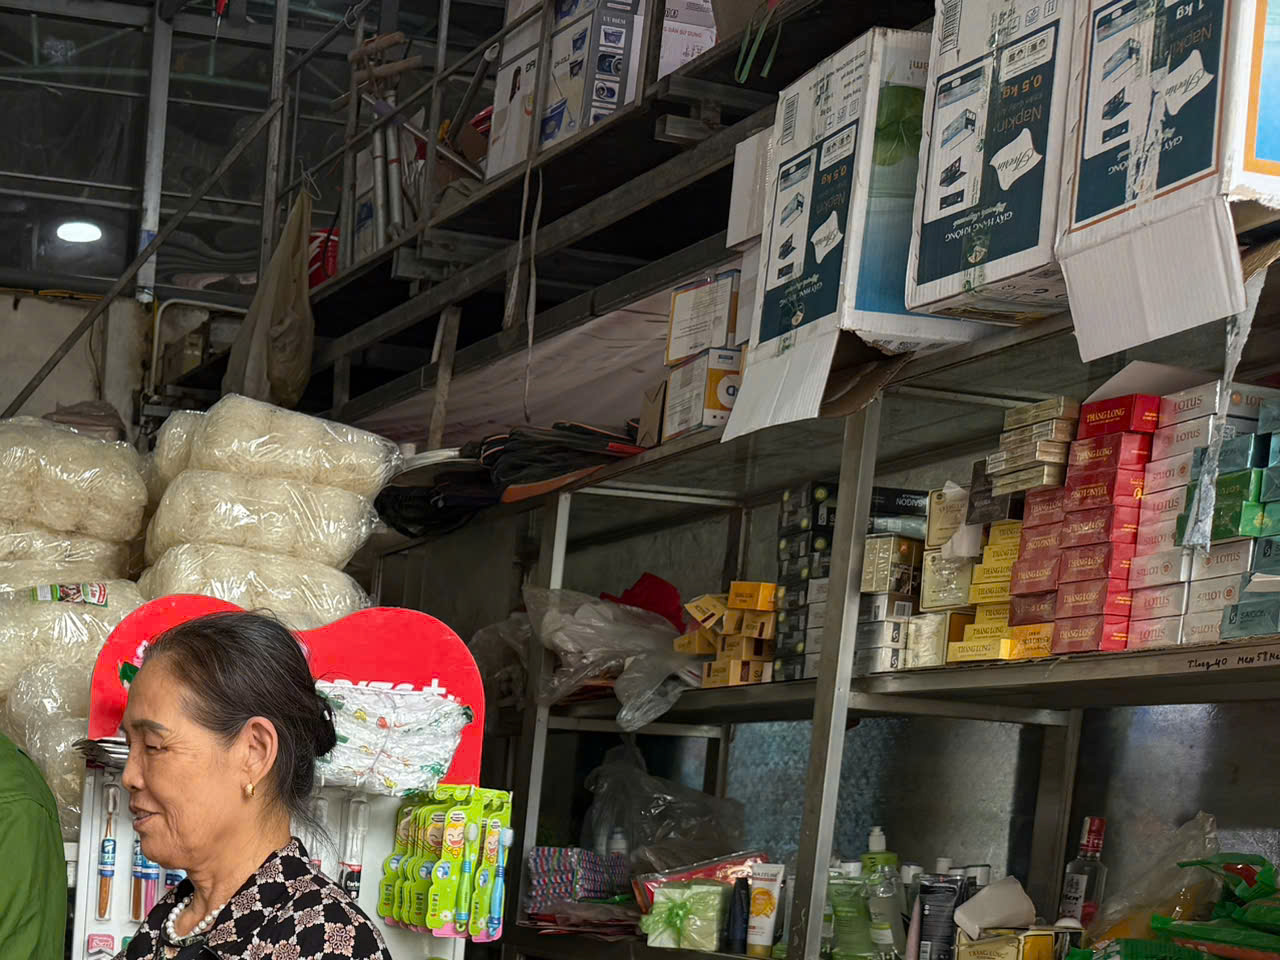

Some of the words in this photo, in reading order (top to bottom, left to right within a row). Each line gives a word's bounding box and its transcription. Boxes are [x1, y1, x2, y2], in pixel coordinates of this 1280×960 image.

[1002, 80, 1018, 98] kg
[1173, 396, 1203, 412] LOTUS
[1175, 428, 1201, 443] LOTUS
[1152, 499, 1180, 513] LOTUS
[1215, 552, 1241, 565] LOTUS
[1143, 596, 1170, 608] LOTUS
[1139, 627, 1166, 641] LOTUS
